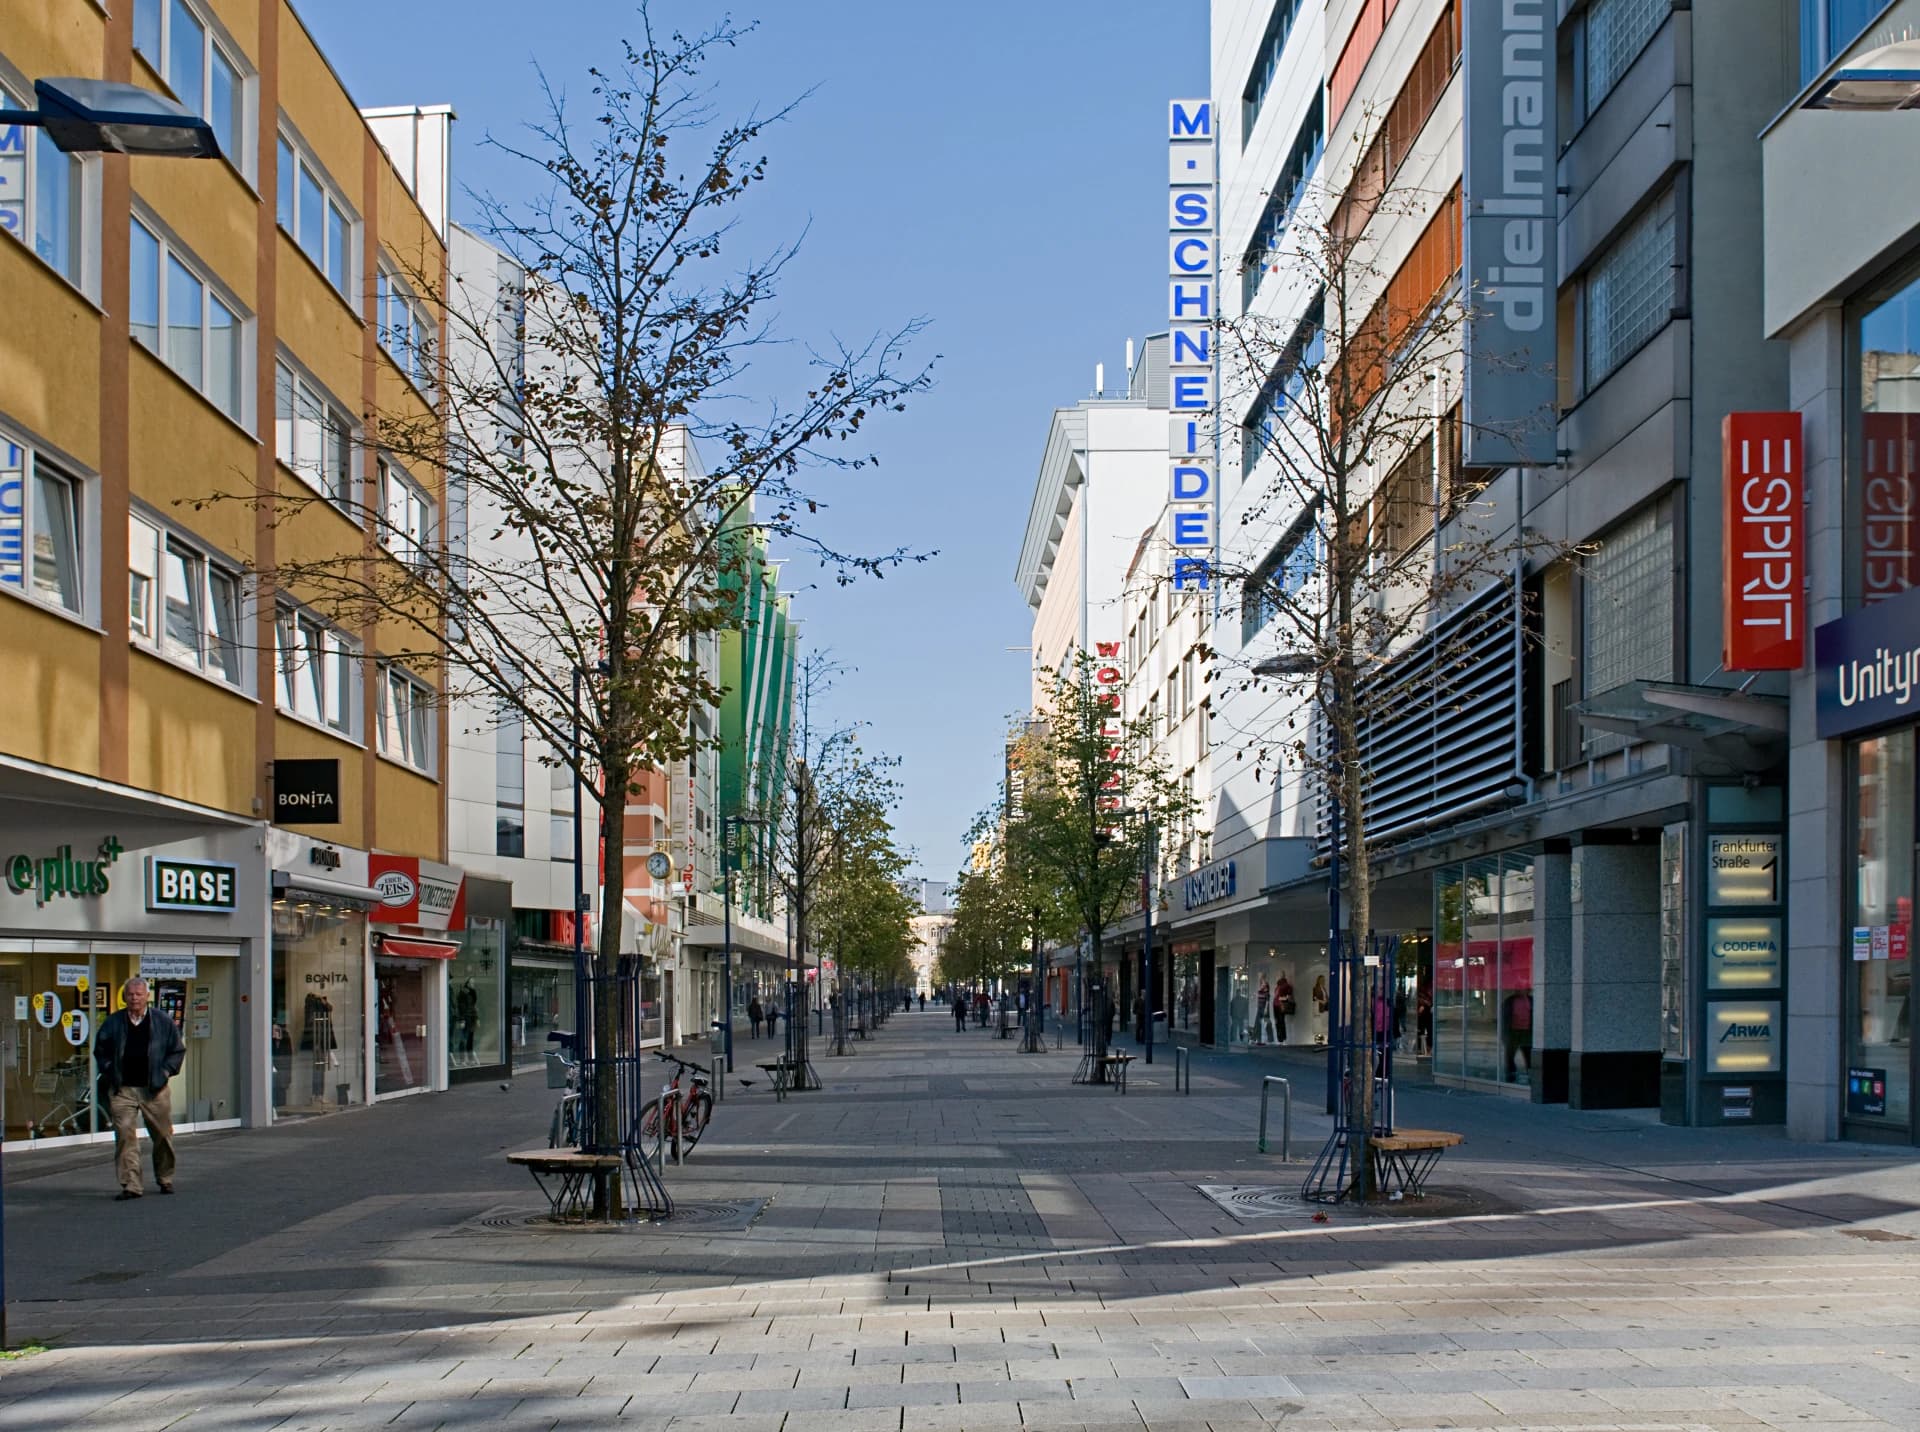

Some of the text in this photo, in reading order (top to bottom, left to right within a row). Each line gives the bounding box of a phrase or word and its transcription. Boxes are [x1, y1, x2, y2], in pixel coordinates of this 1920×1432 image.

[1484, 0, 1544, 332] dielmann
[1742, 439, 1791, 641] ESPRIT
[279, 790, 333, 808] BONITA
[1712, 839, 1776, 852] Frankfurter
[162, 868, 230, 902] BASE
[1712, 855, 1777, 901] Straße 1
[378, 882, 410, 896] ZEISS
[1723, 941, 1777, 952] CODEMA
[1720, 1023, 1770, 1043] ARWA
